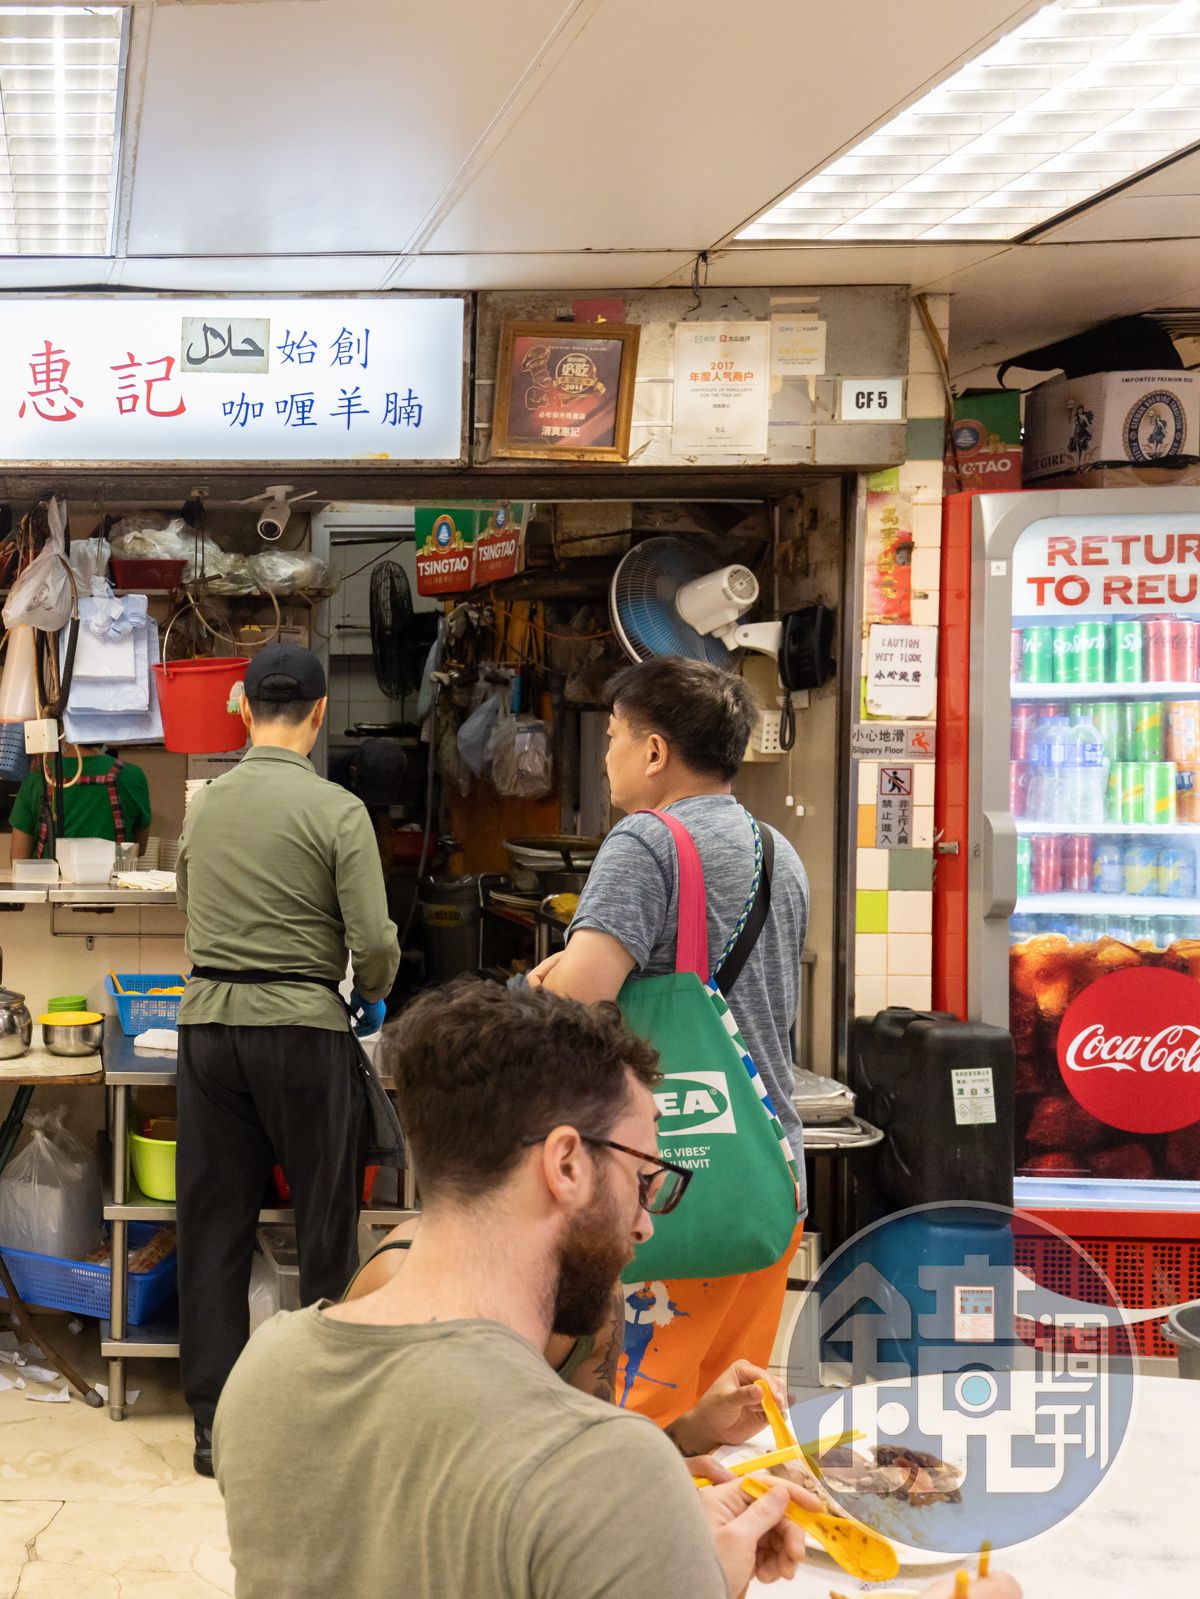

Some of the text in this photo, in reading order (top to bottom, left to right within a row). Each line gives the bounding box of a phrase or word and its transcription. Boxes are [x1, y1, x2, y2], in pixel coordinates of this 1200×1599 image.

[186, 323, 265, 366] حلال
[276, 326, 370, 369] 始創
[710, 361, 735, 370] 2017
[689, 371, 754, 383] 年度人气商户
[223, 385, 423, 432] 咖喱羊腩
[855, 391, 888, 410] CF 5
[479, 539, 516, 562] TSINGTAO
[417, 556, 469, 577] TSINGTAO
[1027, 574, 1091, 606] TO
[881, 638, 920, 649] CAUTION
[875, 652, 895, 662] WET
[852, 729, 905, 743] 小心地滑
[852, 745, 904, 755] Slippery Floor
[881, 799, 893, 844] 禁止進入
[897, 799, 909, 845] 非工作人員
[653, 1090, 720, 1116] EA
